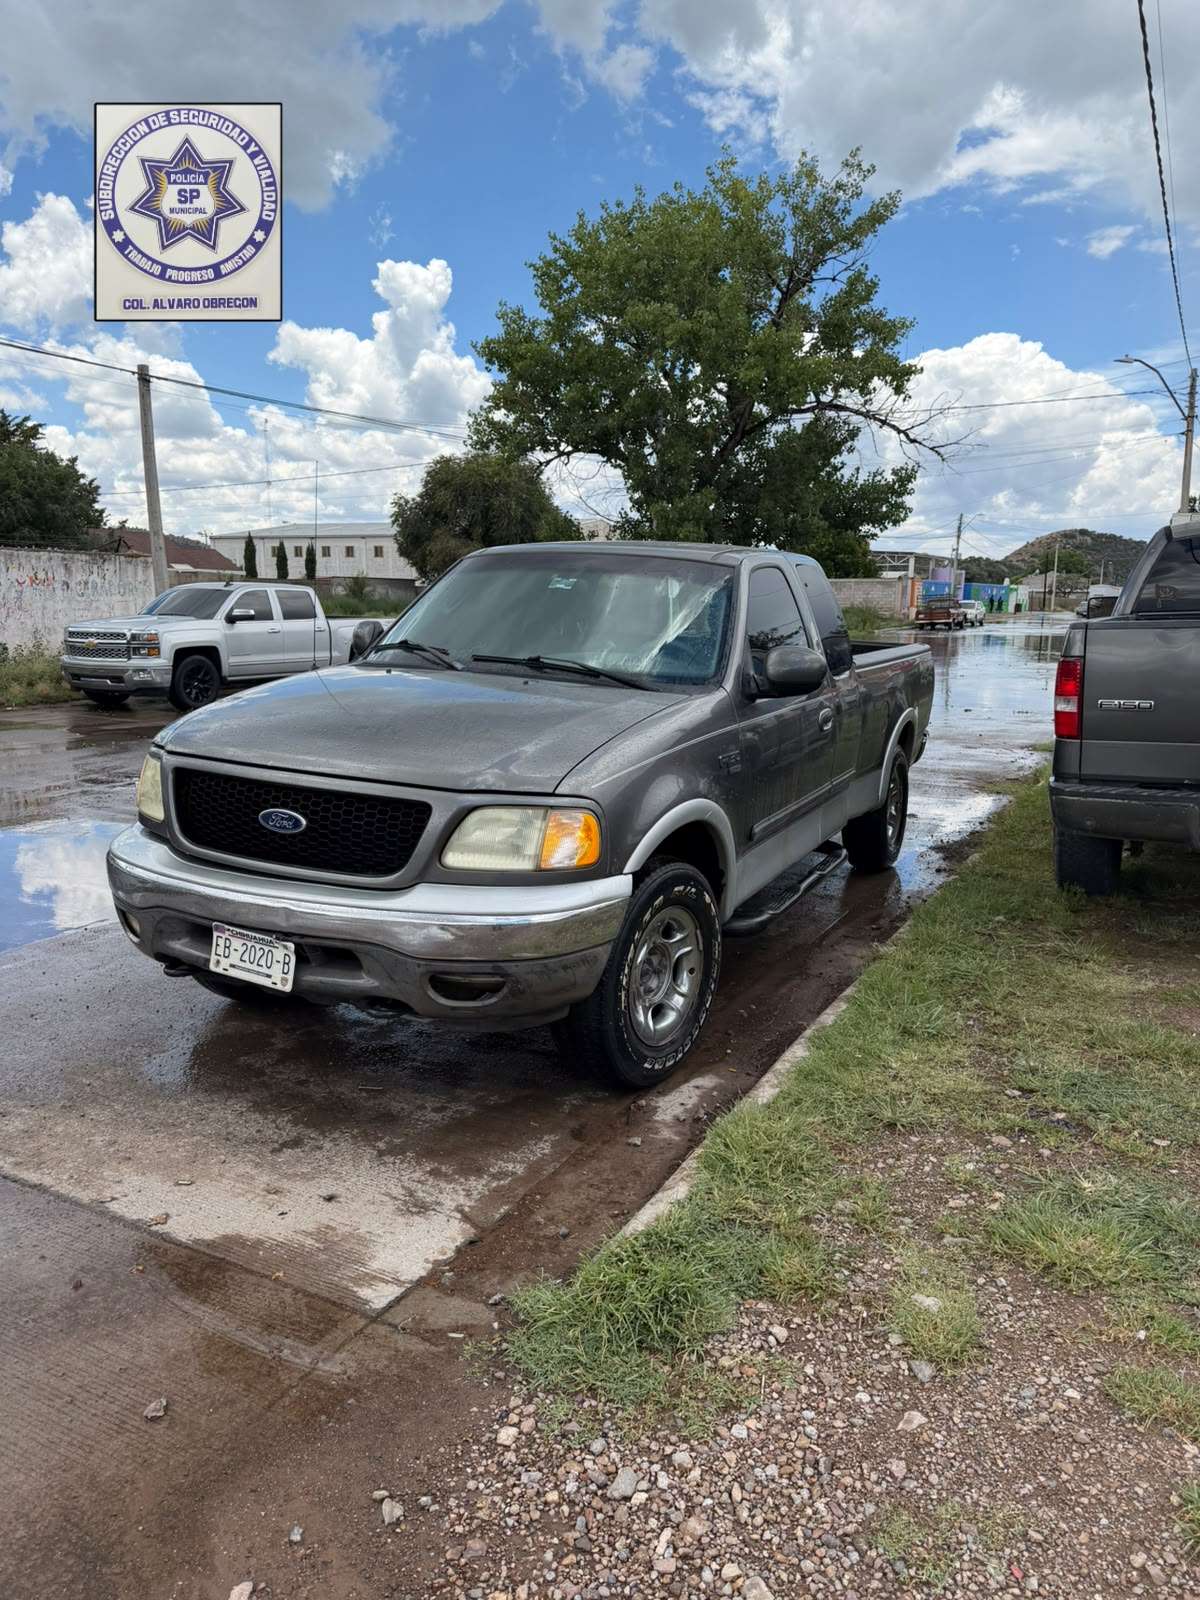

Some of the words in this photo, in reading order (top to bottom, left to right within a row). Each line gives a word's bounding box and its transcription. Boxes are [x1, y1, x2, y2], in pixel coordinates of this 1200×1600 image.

[269, 812, 296, 829] Ford
[230, 929, 275, 945] CHIHUAHUA
[215, 935, 292, 975] EB-2020-B
